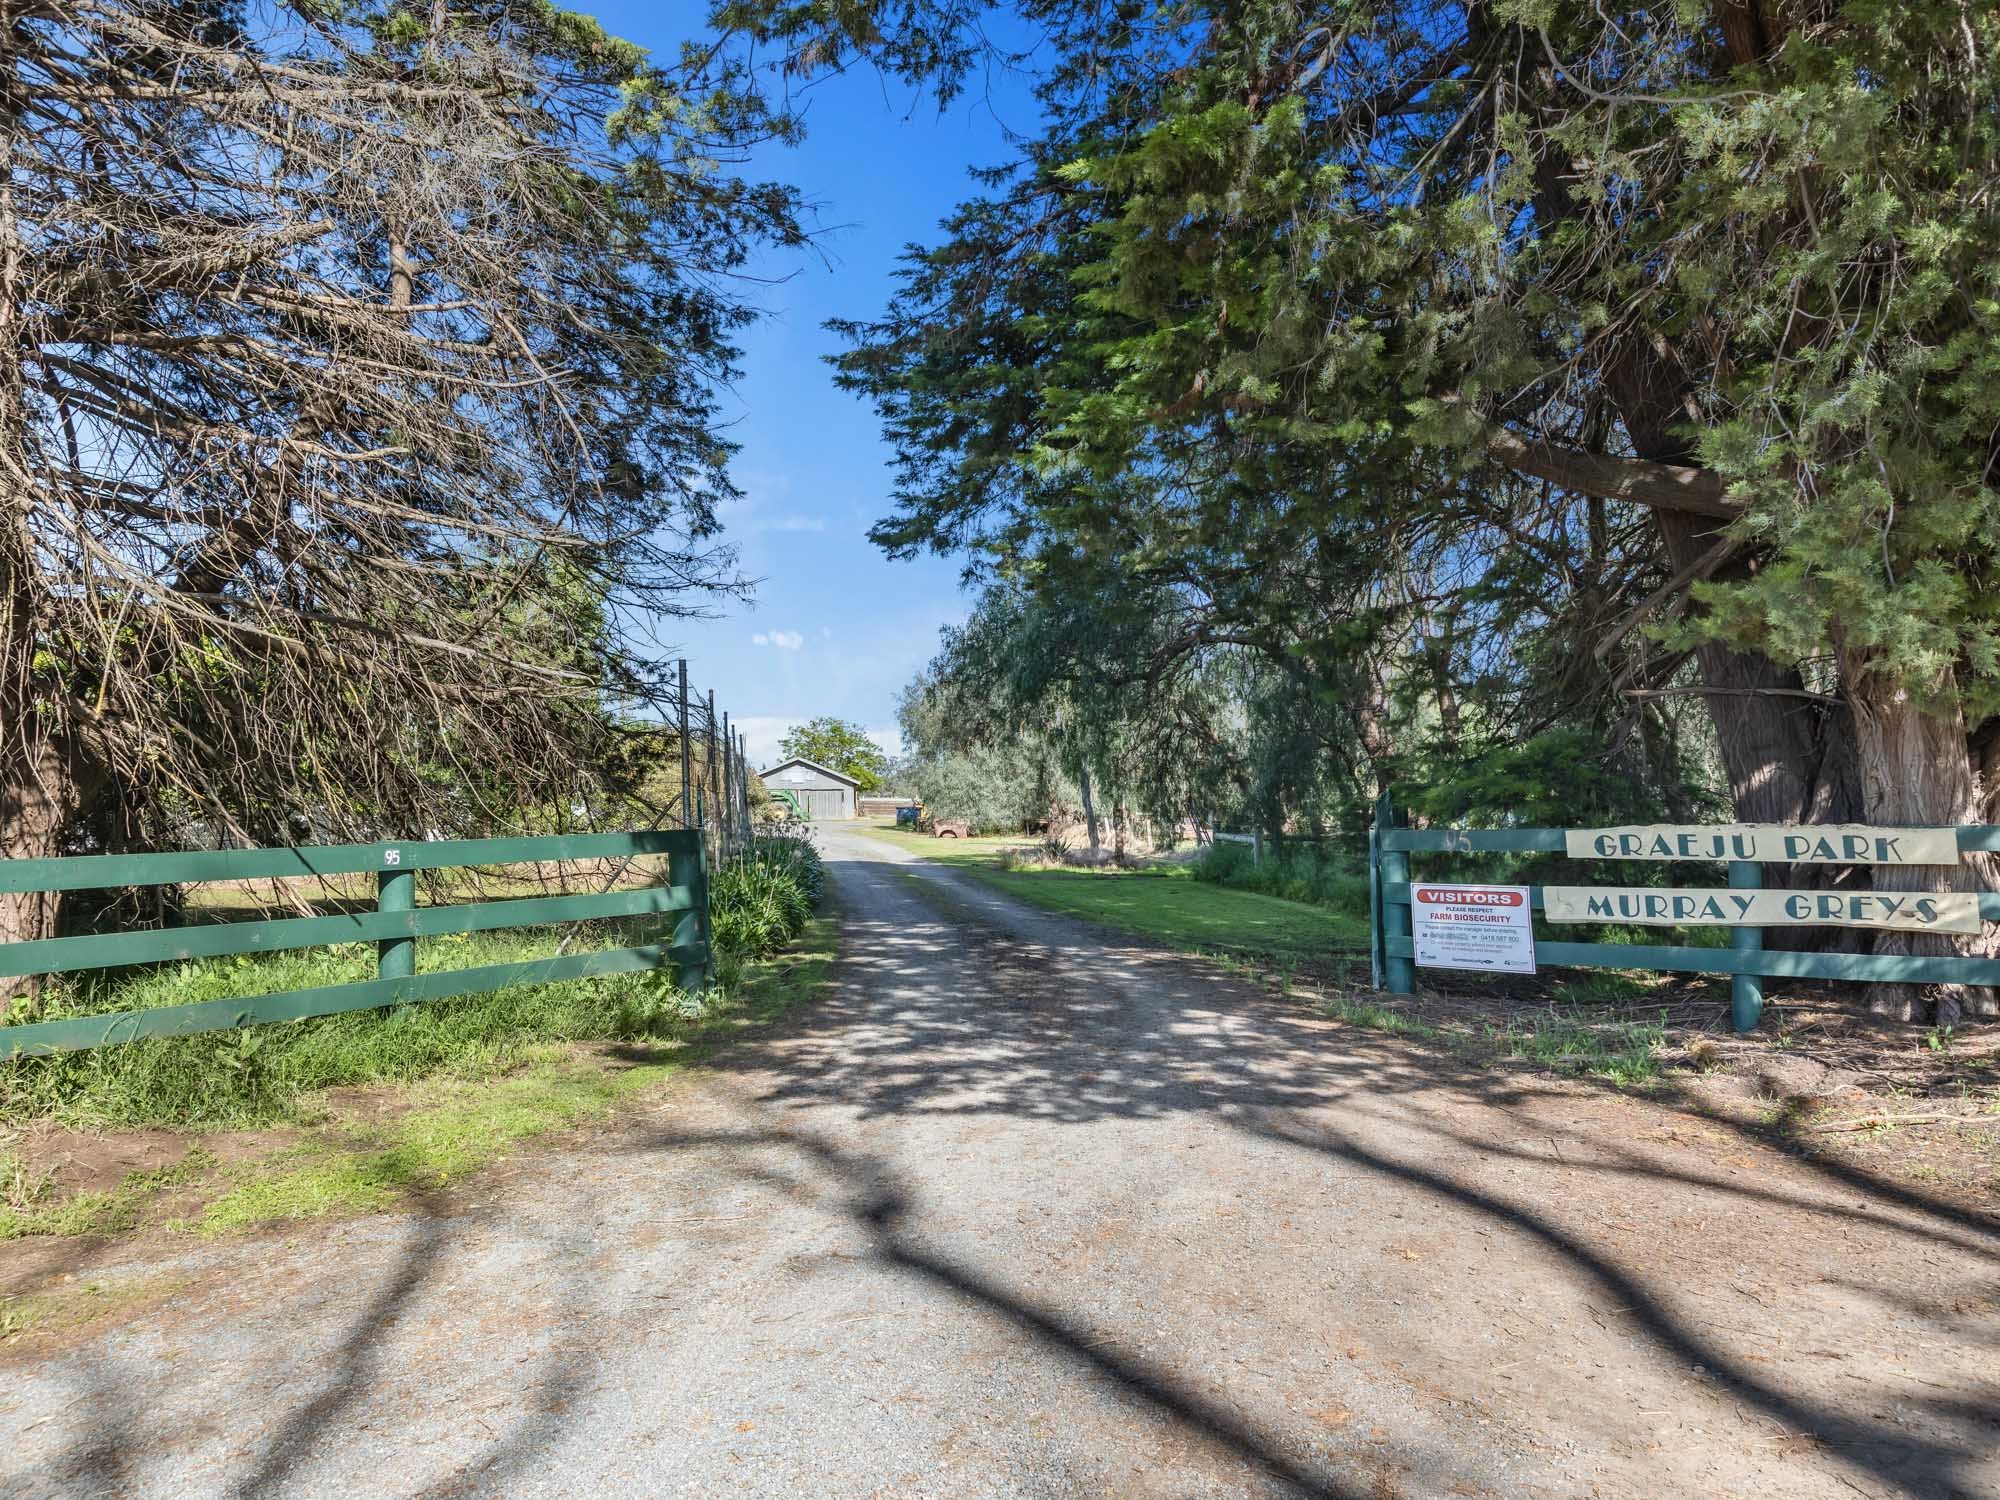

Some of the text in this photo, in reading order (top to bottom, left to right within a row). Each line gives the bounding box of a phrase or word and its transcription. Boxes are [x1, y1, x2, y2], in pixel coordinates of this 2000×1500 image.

[1594, 833, 1902, 862] GRAEJU PARK
[385, 849, 400, 865] 95
[1427, 891, 1512, 904] VISITORS
[1587, 894, 1938, 923] MURRAY GREYS
[1430, 912, 1512, 923] FARM BIOSECURITY
